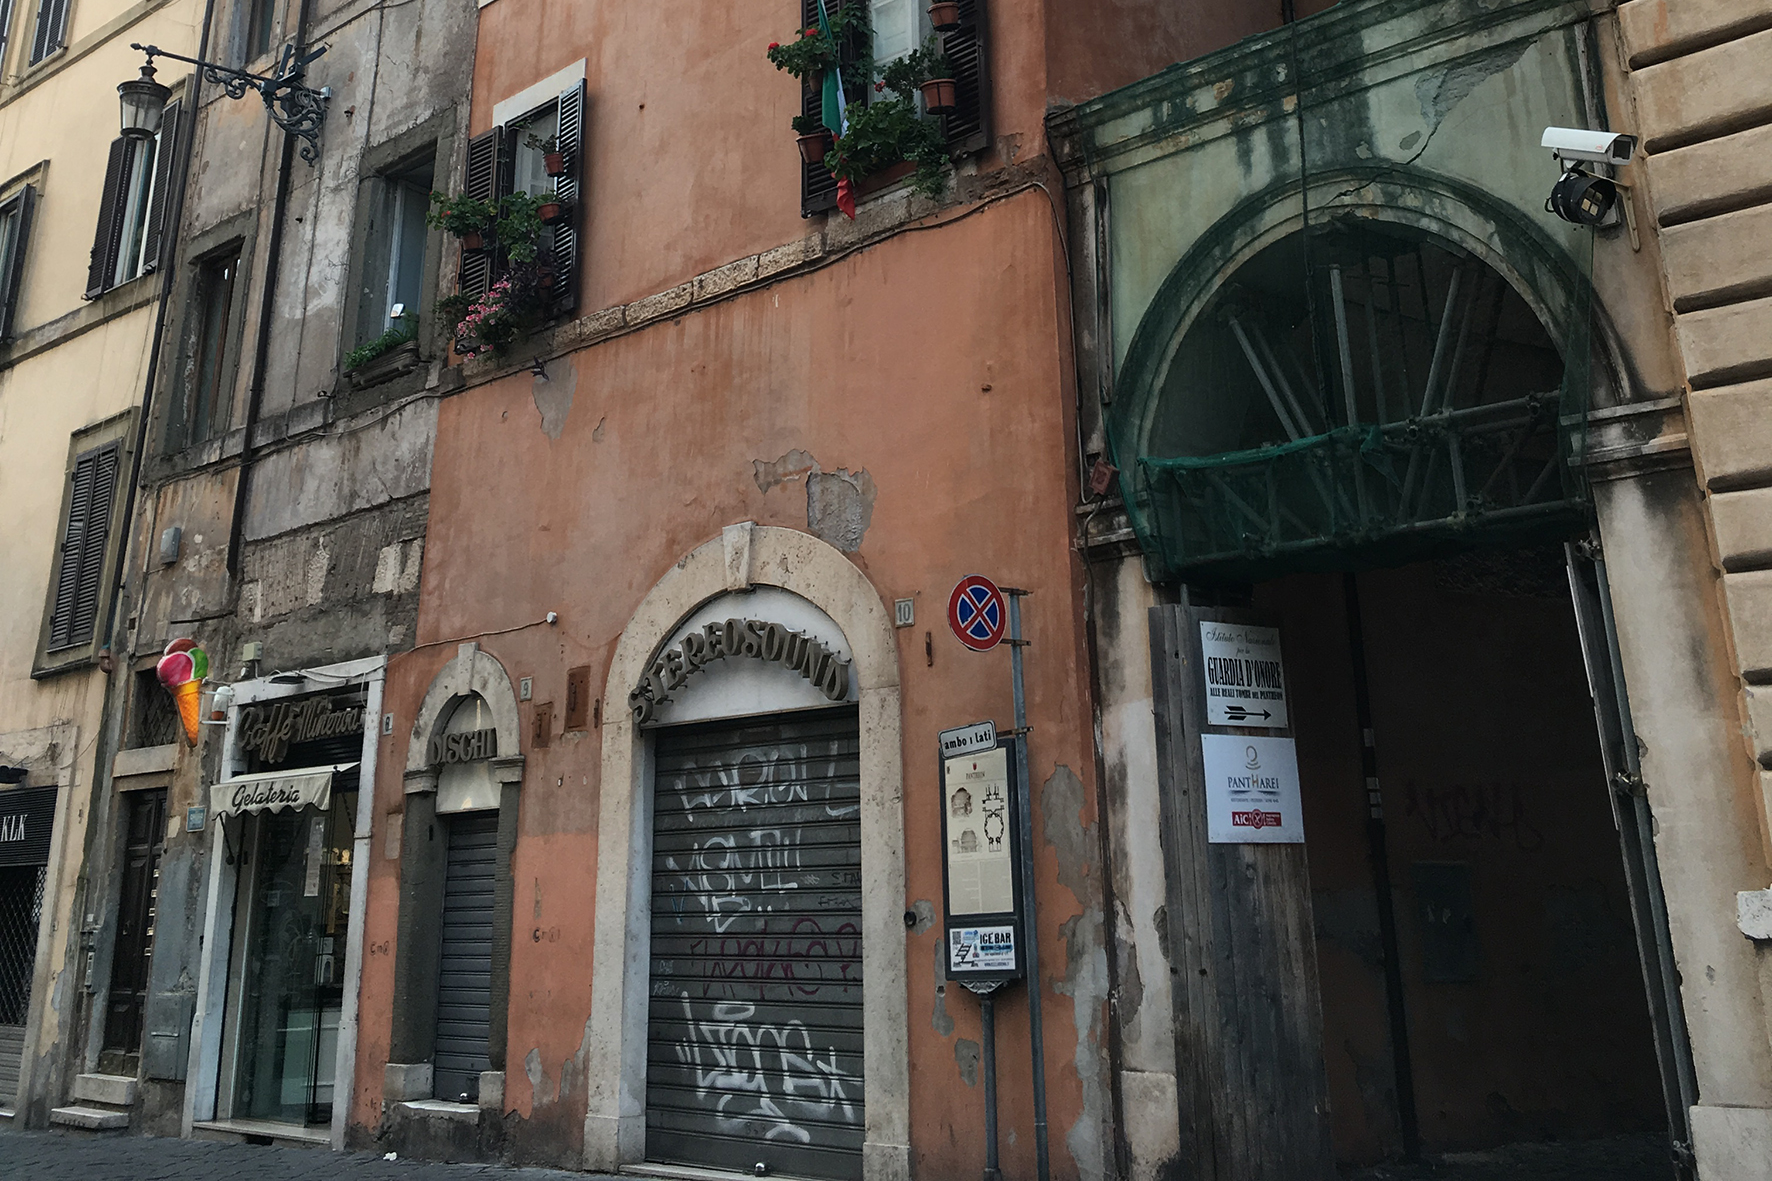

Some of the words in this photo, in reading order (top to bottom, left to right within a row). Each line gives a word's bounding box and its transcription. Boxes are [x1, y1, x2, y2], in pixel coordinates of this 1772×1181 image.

[897, 604, 912, 623] 10
[628, 618, 849, 723] STEREOSOUND
[1207, 656, 1245, 687] GUARDIA
[1245, 659, 1282, 689] D'ONORE
[523, 681, 530, 697] 9
[430, 727, 498, 765] DISCHI
[944, 736, 967, 750] ambo
[975, 729, 991, 743] lati
[1227, 773, 1279, 789] PANTHAREI
[232, 783, 300, 813] Gelateria
[980, 932, 993, 945] ICE
[995, 932, 1011, 944] BAR
